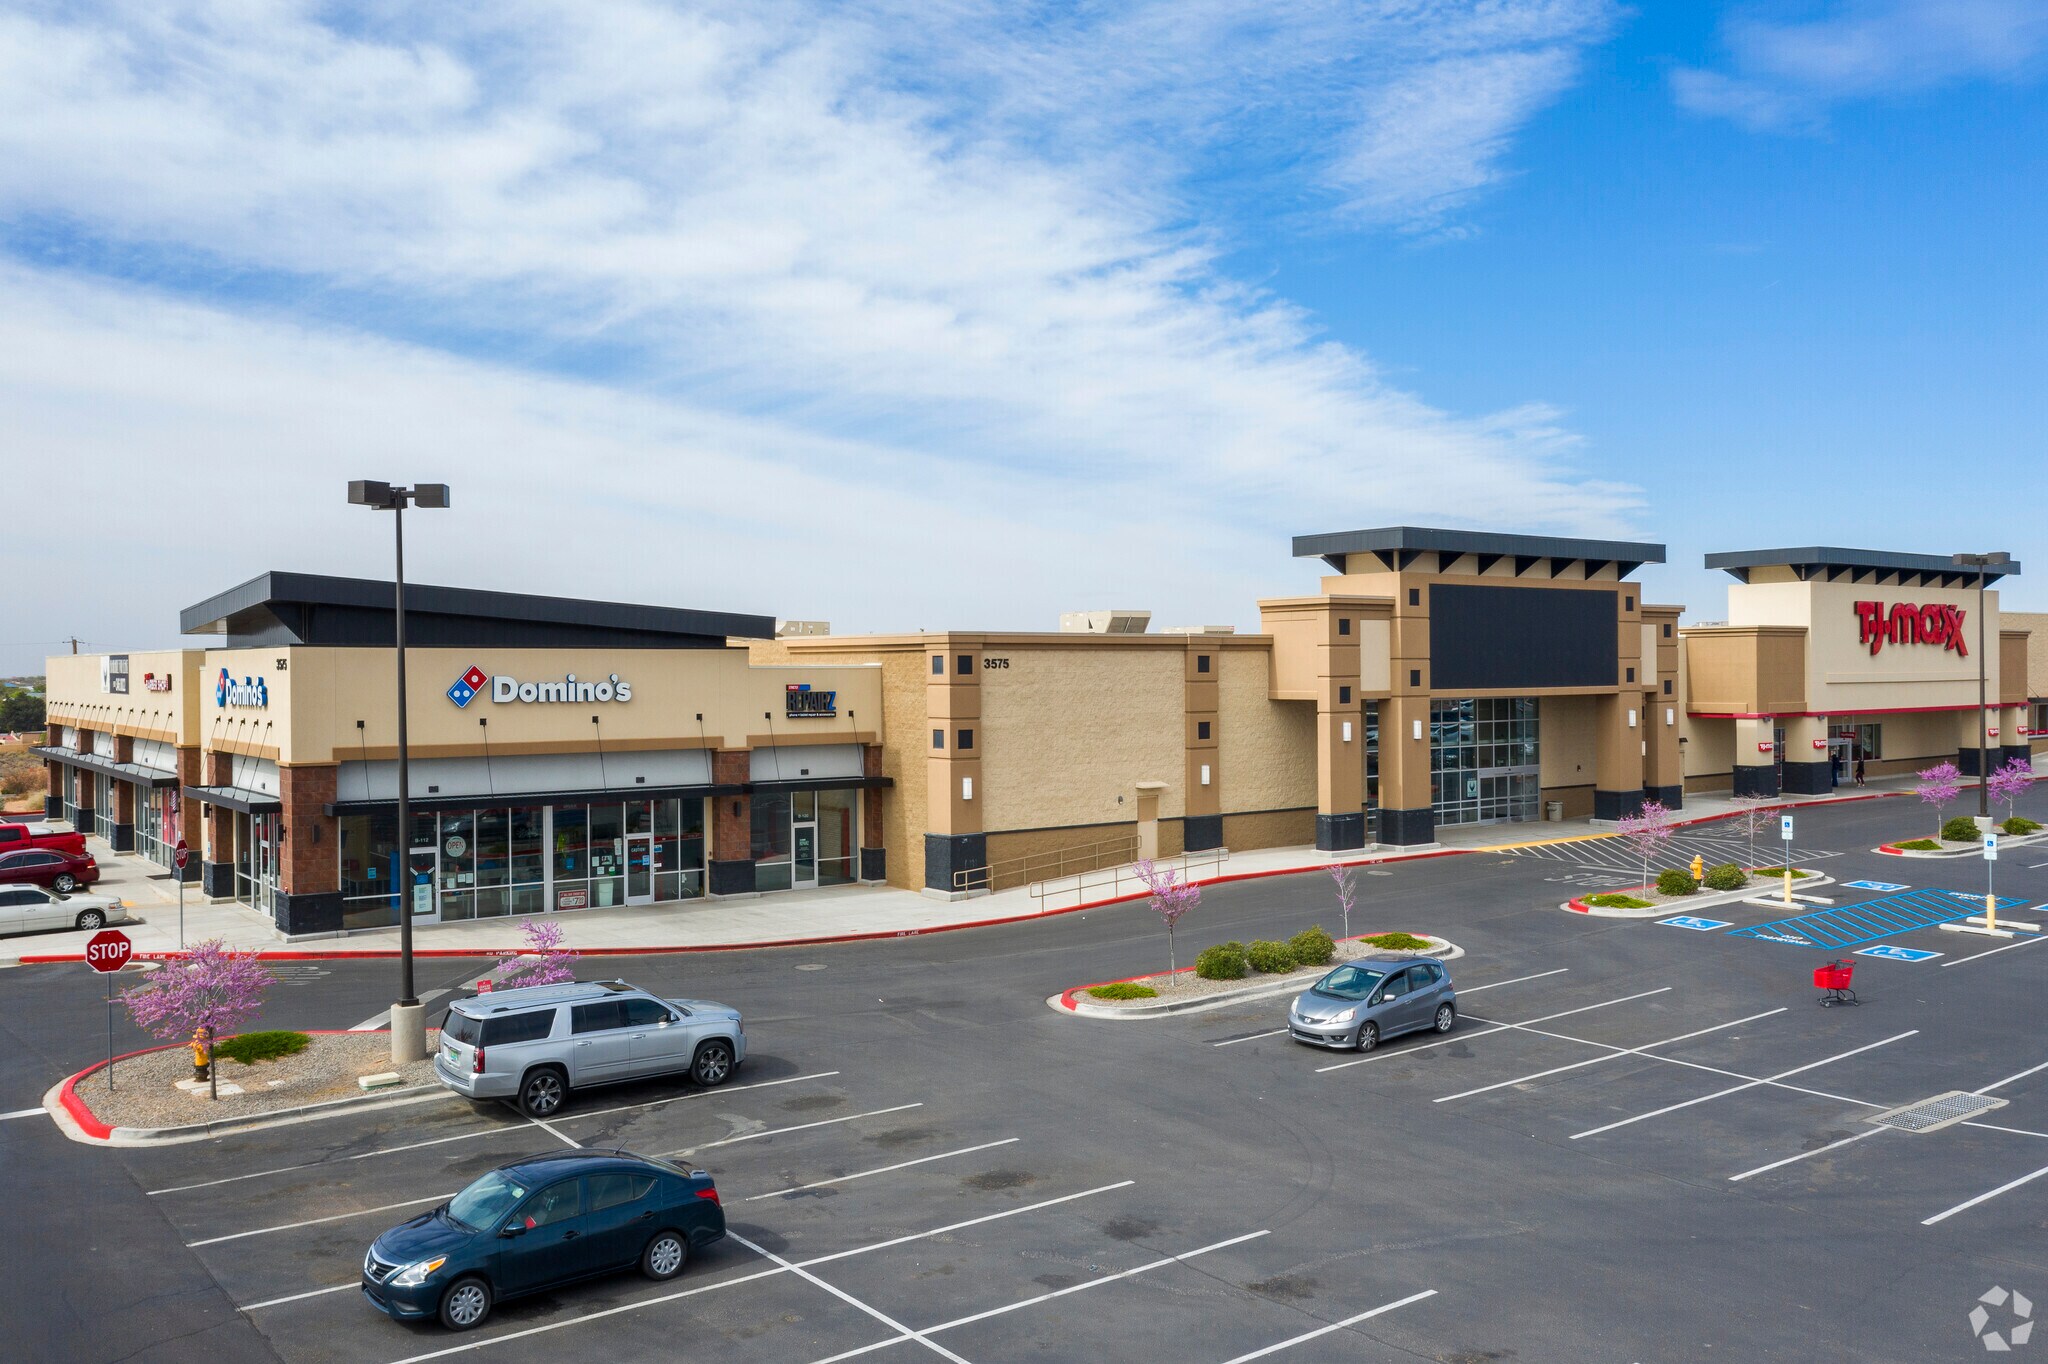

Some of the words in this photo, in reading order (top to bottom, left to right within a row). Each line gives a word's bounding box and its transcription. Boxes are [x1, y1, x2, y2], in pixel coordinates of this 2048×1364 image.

[984, 658, 1009, 669] 3575
[226, 676, 267, 706] Domino's
[492, 673, 632, 703] Domino's
[786, 692, 836, 711] REPAIRZ
[177, 848, 187, 861] STOP
[447, 841, 464, 850] OPEN
[89, 941, 129, 961] STOP
